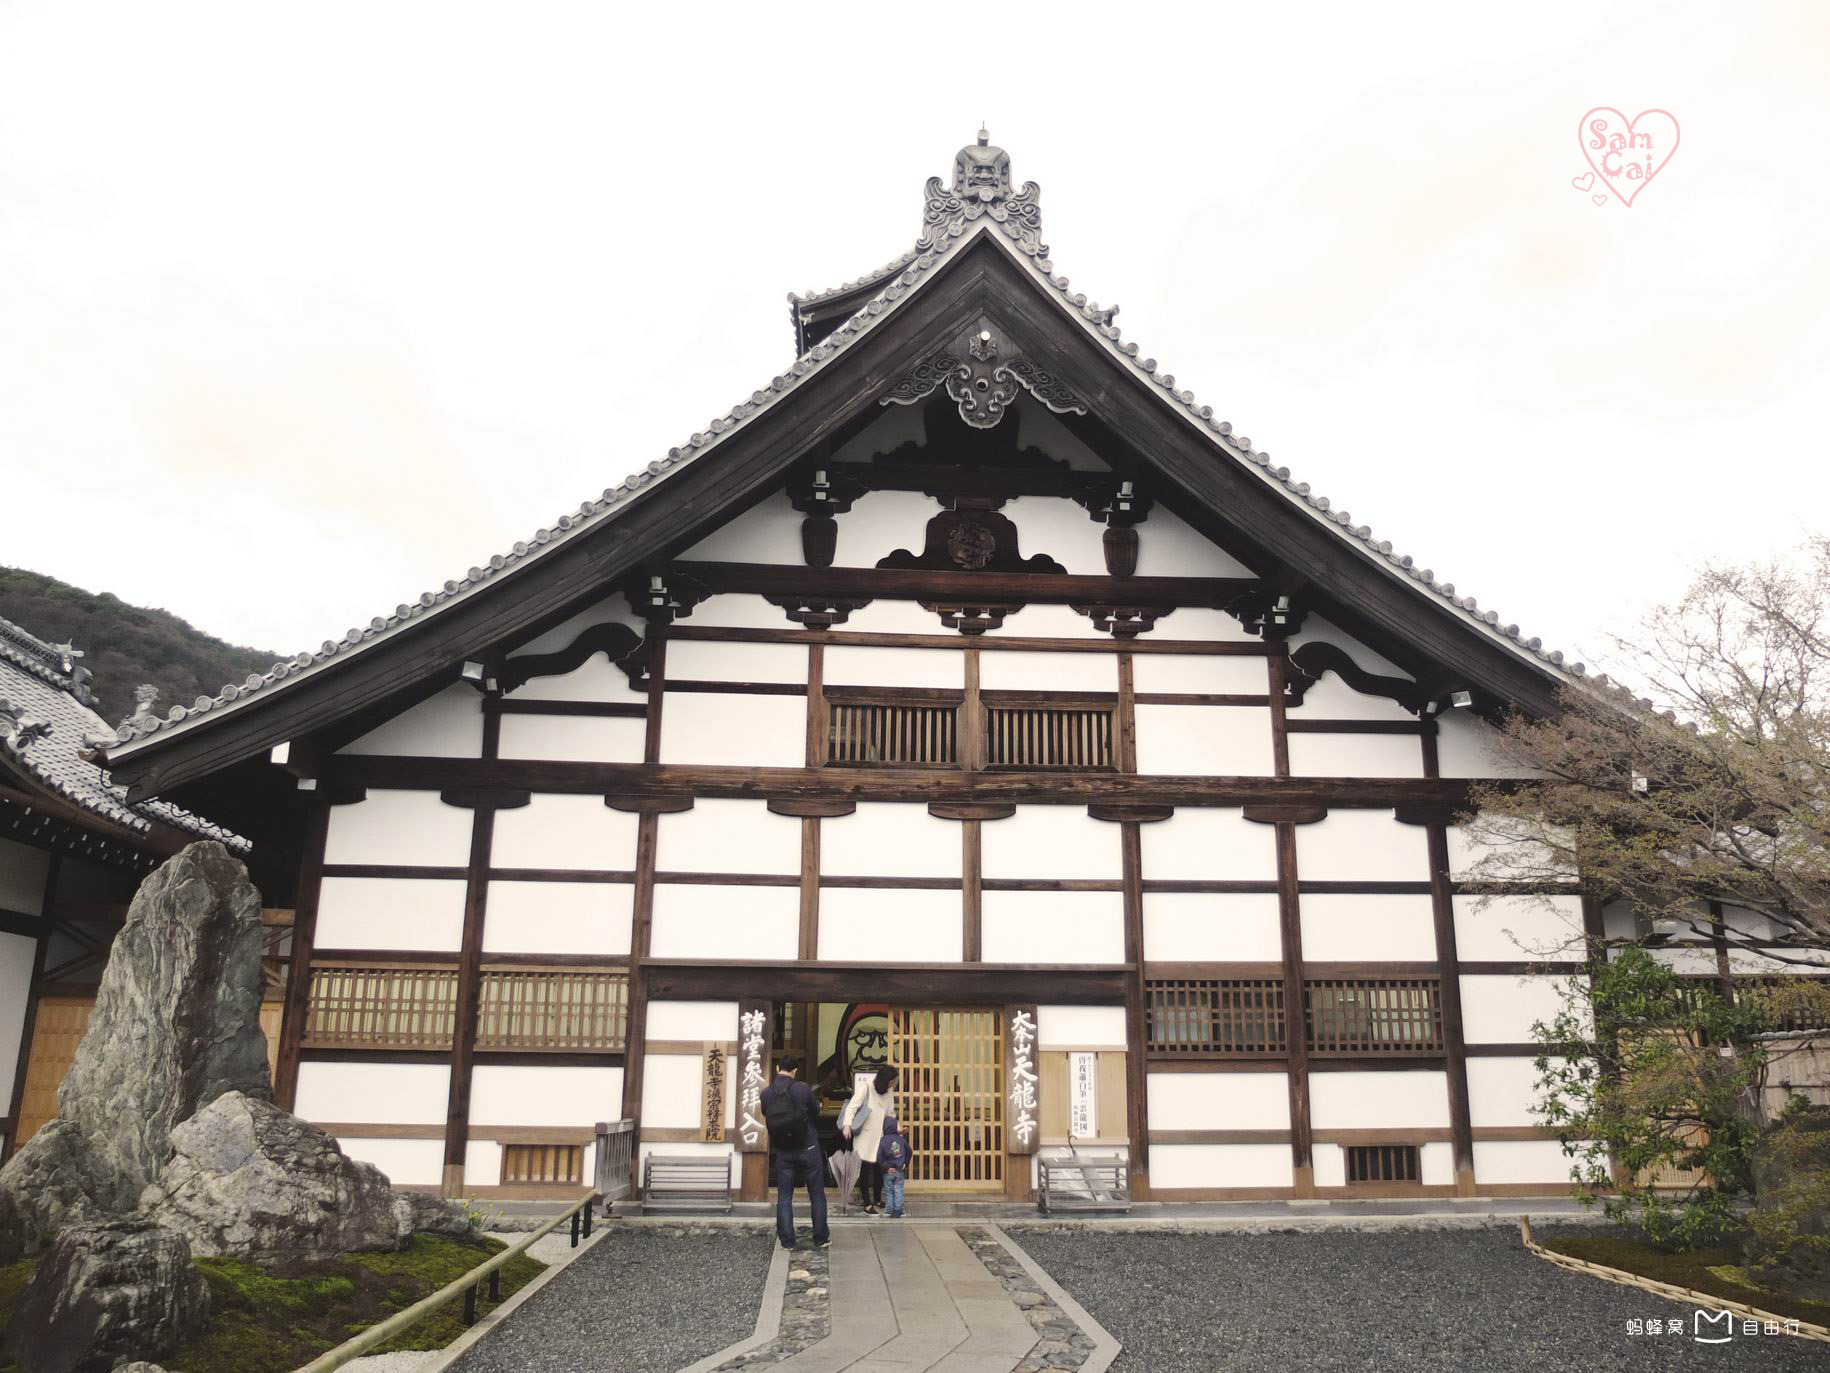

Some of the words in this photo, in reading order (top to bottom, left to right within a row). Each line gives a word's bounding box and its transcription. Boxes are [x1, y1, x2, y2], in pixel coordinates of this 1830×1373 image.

[1010, 1010, 1038, 1145] 大本山天龍寺
